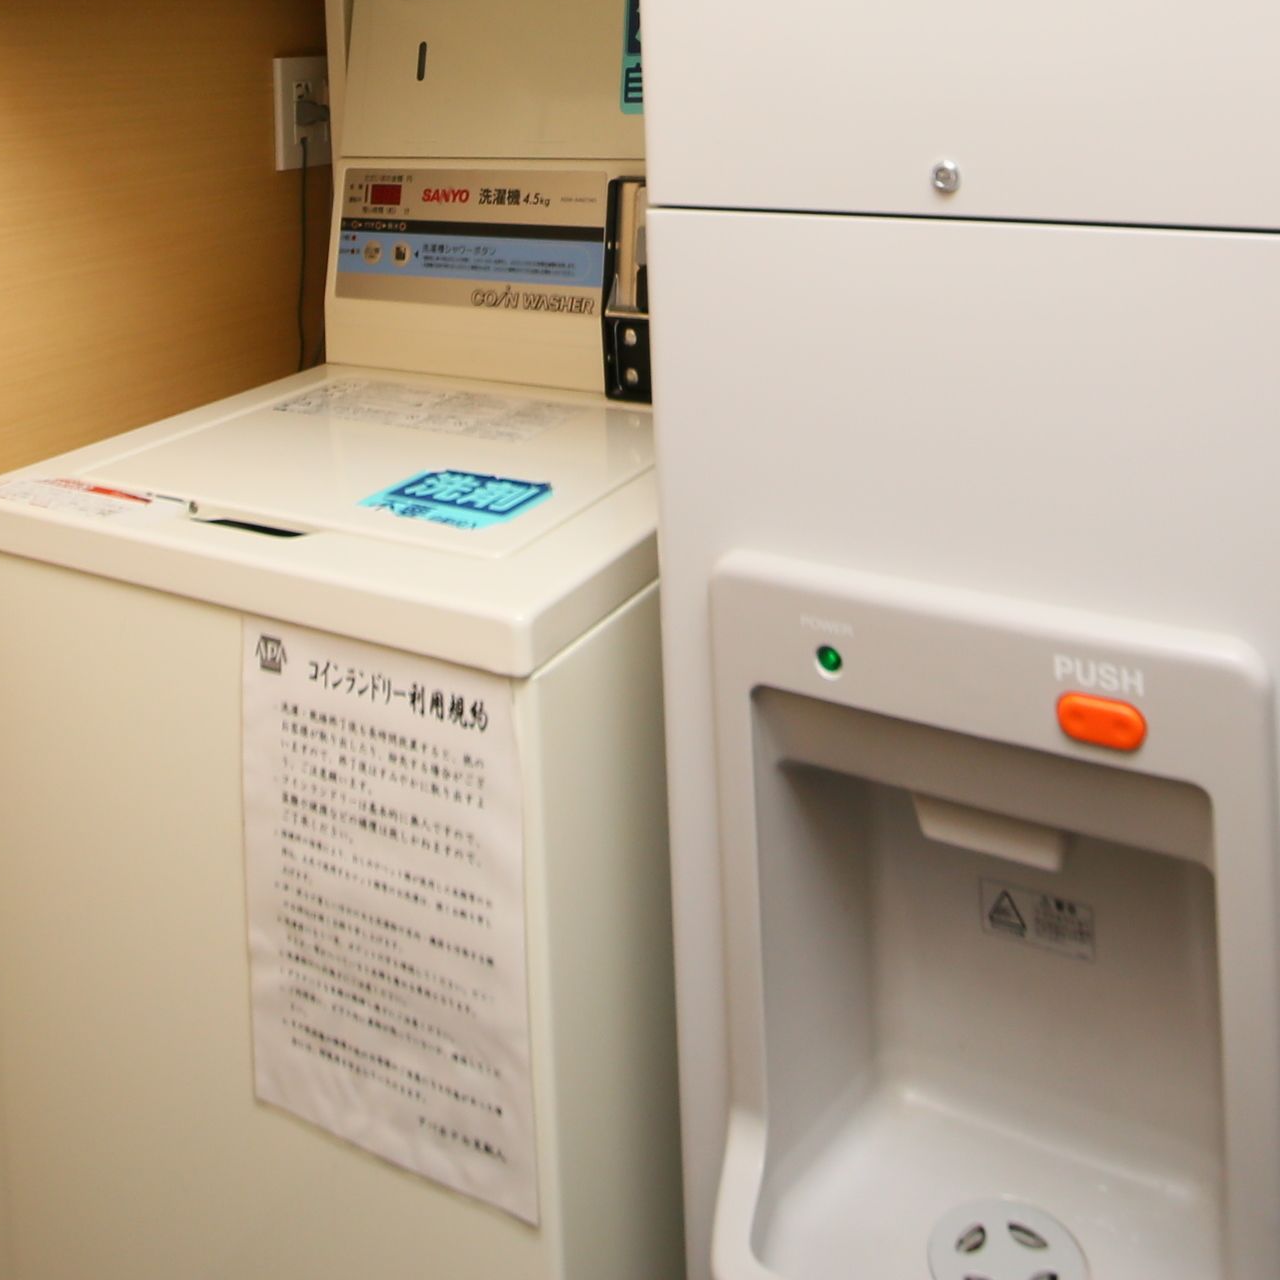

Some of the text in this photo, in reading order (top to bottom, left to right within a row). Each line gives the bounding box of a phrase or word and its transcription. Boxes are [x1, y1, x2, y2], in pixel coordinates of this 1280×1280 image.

[421, 187, 470, 204] SANYO
[478, 187, 551, 208] 洗濯機 4.5kg
[522, 291, 597, 316] WASHER
[1053, 653, 1145, 697] PUSH
